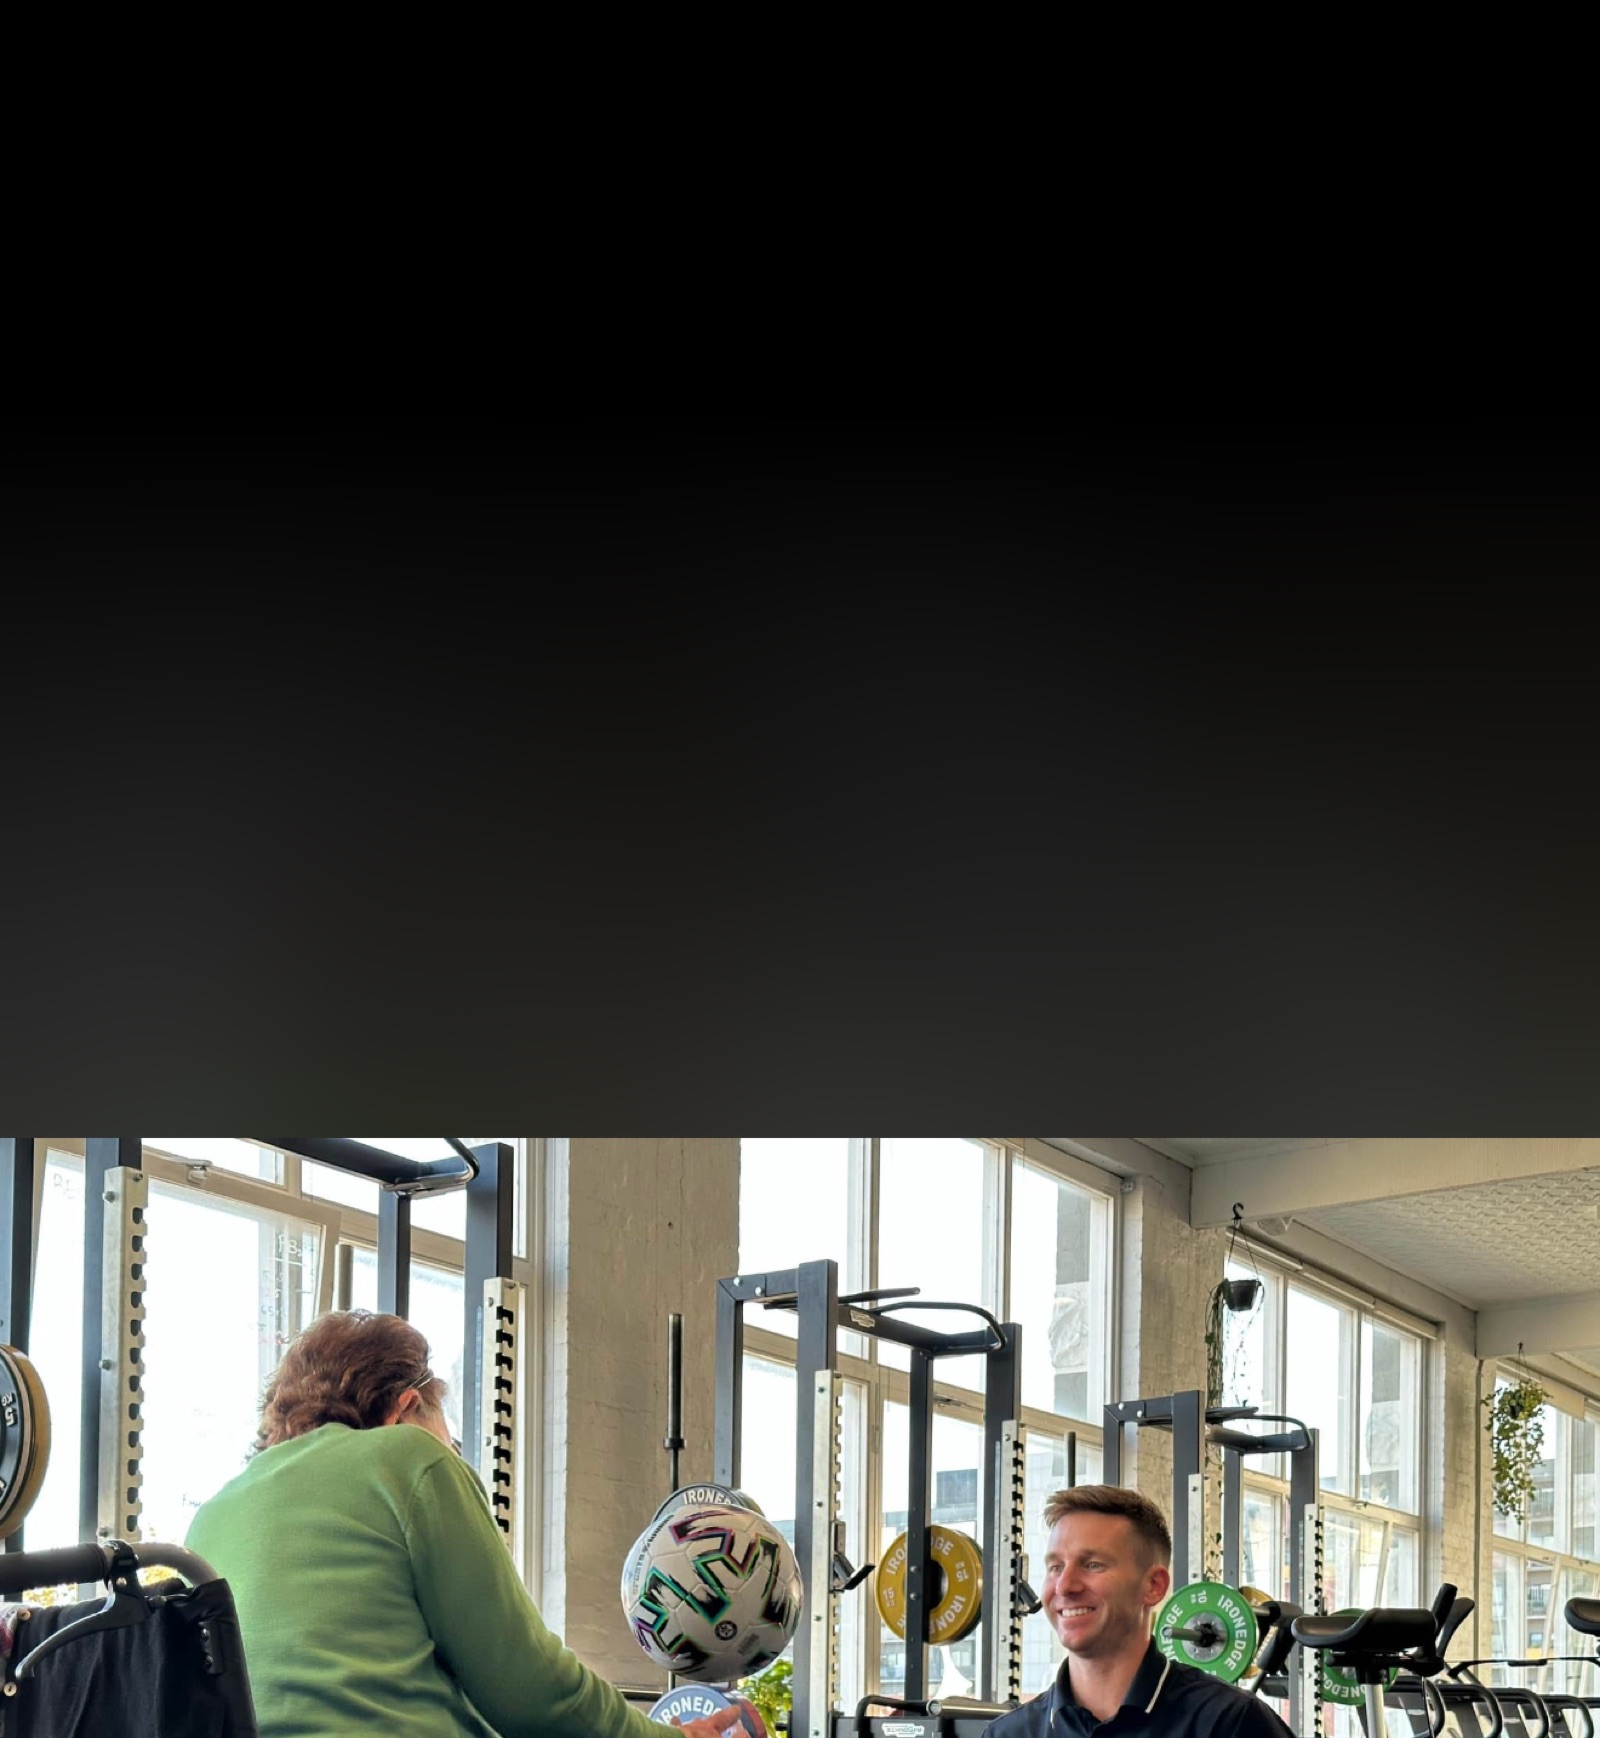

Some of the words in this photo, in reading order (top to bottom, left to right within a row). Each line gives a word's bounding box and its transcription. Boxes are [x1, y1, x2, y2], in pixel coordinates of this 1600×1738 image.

[683, 1489, 732, 1504] IRONE
[1197, 1590, 1208, 1604] 10
[1217, 1594, 1247, 1671] IRONEDGE
